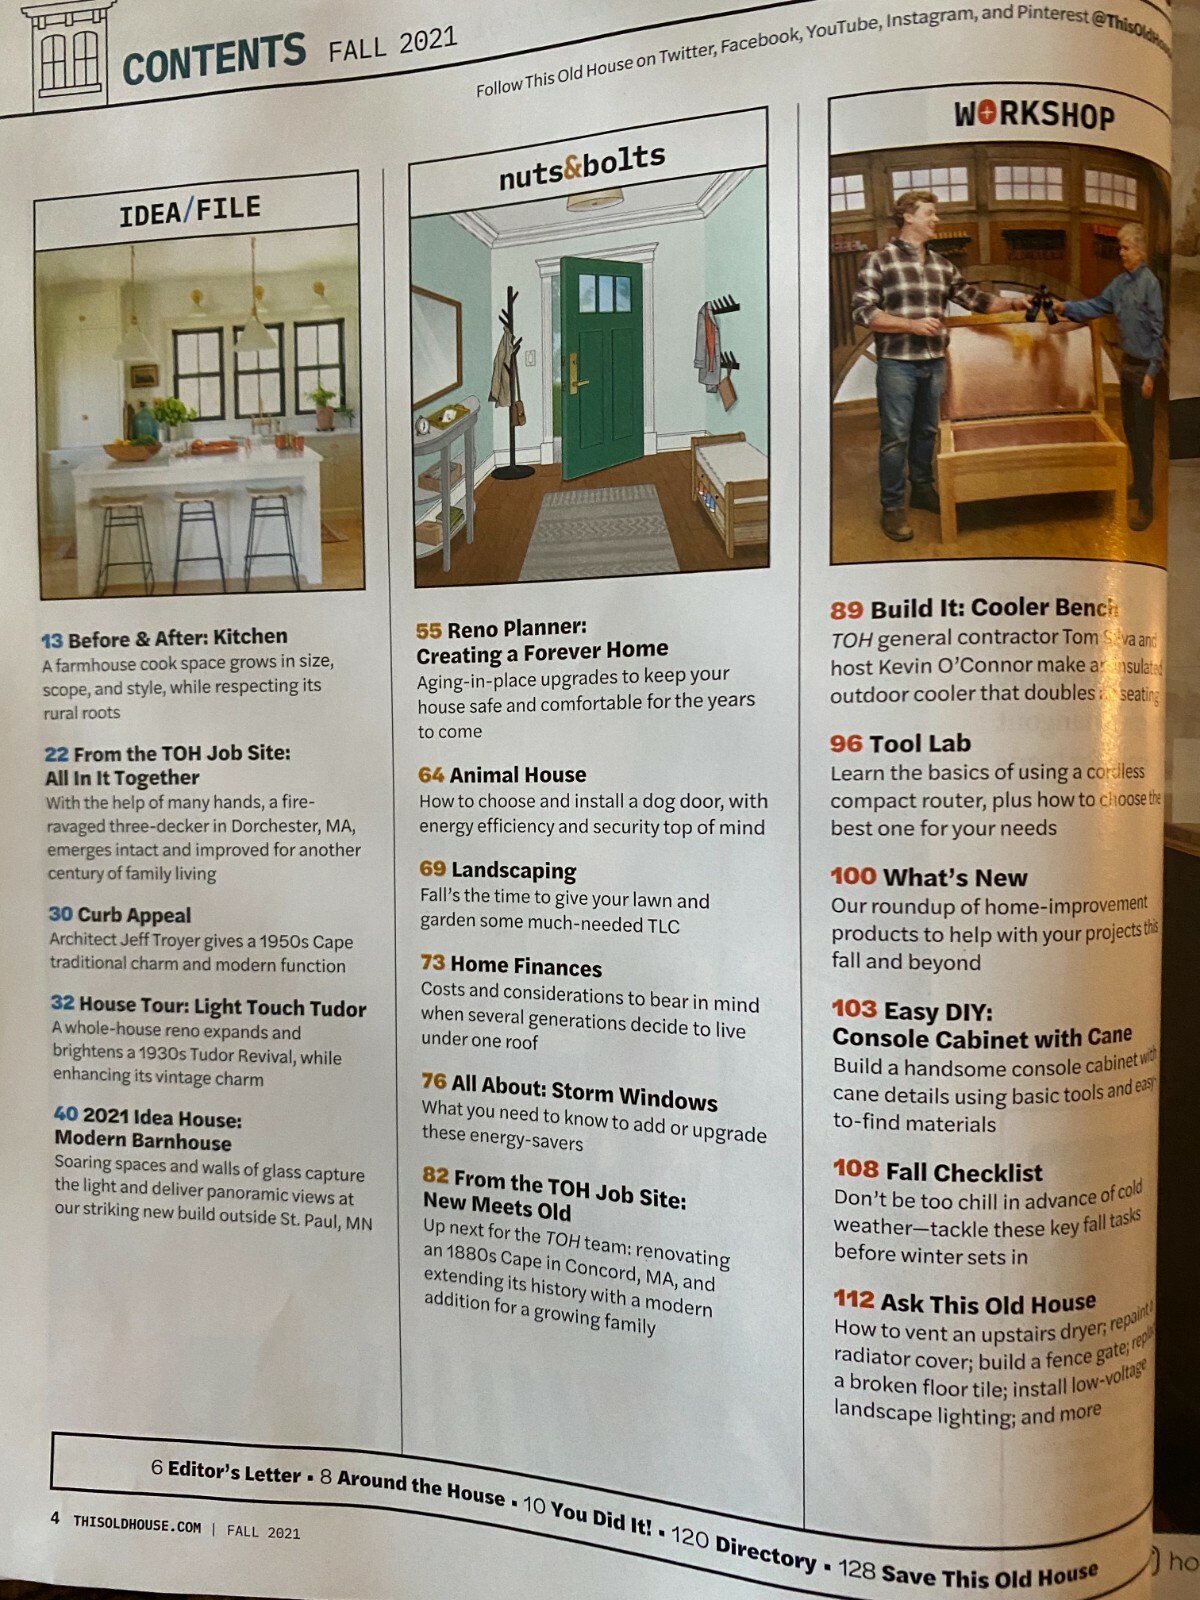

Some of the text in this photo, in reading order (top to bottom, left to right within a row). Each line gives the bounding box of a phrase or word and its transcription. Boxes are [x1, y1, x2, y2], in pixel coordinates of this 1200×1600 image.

[123, 26, 457, 86] CONTENTS FALL 2021
[476, 79, 523, 98] Follow
[525, 72, 555, 89] This
[557, 64, 583, 83] Old
[586, 58, 634, 77] House
[636, 54, 656, 68] on
[659, 43, 718, 65] Twitter,
[720, 27, 803, 54] Facebook,
[806, 17, 883, 39] YouTube,
[886, 8, 978, 28] Instagram,
[981, 5, 1013, 20] and
[1017, 5, 1089, 24] Pinterest
[955, 99, 1115, 130] WORKSHOP
[500, 146, 666, 191] nuts&bolts
[120, 195, 261, 228] IDEA/FILE
[831, 601, 863, 619] 89
[871, 600, 932, 619] Build
[941, 599, 964, 617] It:
[972, 597, 1049, 616] Cooler
[42, 627, 287, 648] 13 Before & After: Kitchen
[416, 619, 587, 639] 55 Reno Planner:
[417, 640, 669, 668] Creating a Forever Home
[44, 705, 120, 720] rural roots
[418, 726, 482, 738] to come
[830, 733, 971, 753] 96 Tool Lab
[45, 744, 290, 762] 22 From the TOH Job Site:
[45, 769, 200, 790] All In It Together
[418, 766, 587, 783] 64 Animal House
[831, 819, 1057, 840] best one for your needs
[420, 860, 577, 885] 69 Landscaping
[831, 867, 1028, 887] 100 What’s New
[49, 906, 191, 927] 30 Curb Appeal
[420, 912, 680, 934] garden some much-needed TLC
[50, 955, 346, 973] traditional charm and modern function
[421, 954, 602, 977] 73 Home Finances
[832, 951, 981, 974] fall and beyond
[51, 995, 367, 1019] 32 House Tour: Light Touch Tudor
[832, 999, 992, 1025] 103 Easy DIY:
[833, 1026, 1132, 1049] Console Cabinet with Cane
[422, 1073, 718, 1112] 76 All About: Storm Windows
[54, 1106, 241, 1129] 40 2021 Idea House:
[55, 1129, 232, 1152] Modern Barnhouse
[422, 1124, 583, 1152] these energy-savers
[833, 1159, 1043, 1182] 108 Fall Checklist
[423, 1166, 686, 1210] 82 From the TOH Job Site:
[424, 1192, 571, 1222] New Meets Old
[834, 1242, 1028, 1265] before winter sets in
[833, 1289, 1096, 1315] 112 Ask This Old House
[835, 1398, 1102, 1430] landscape lighting; and more
[50, 1511, 301, 1541] 4 THISOLDHOUSE.COM FALL 2021
[151, 1459, 1099, 1589] 6 Editor’s Letter 8 Around the House 10 You Did It! 120 Directory 128 Save This Old House
